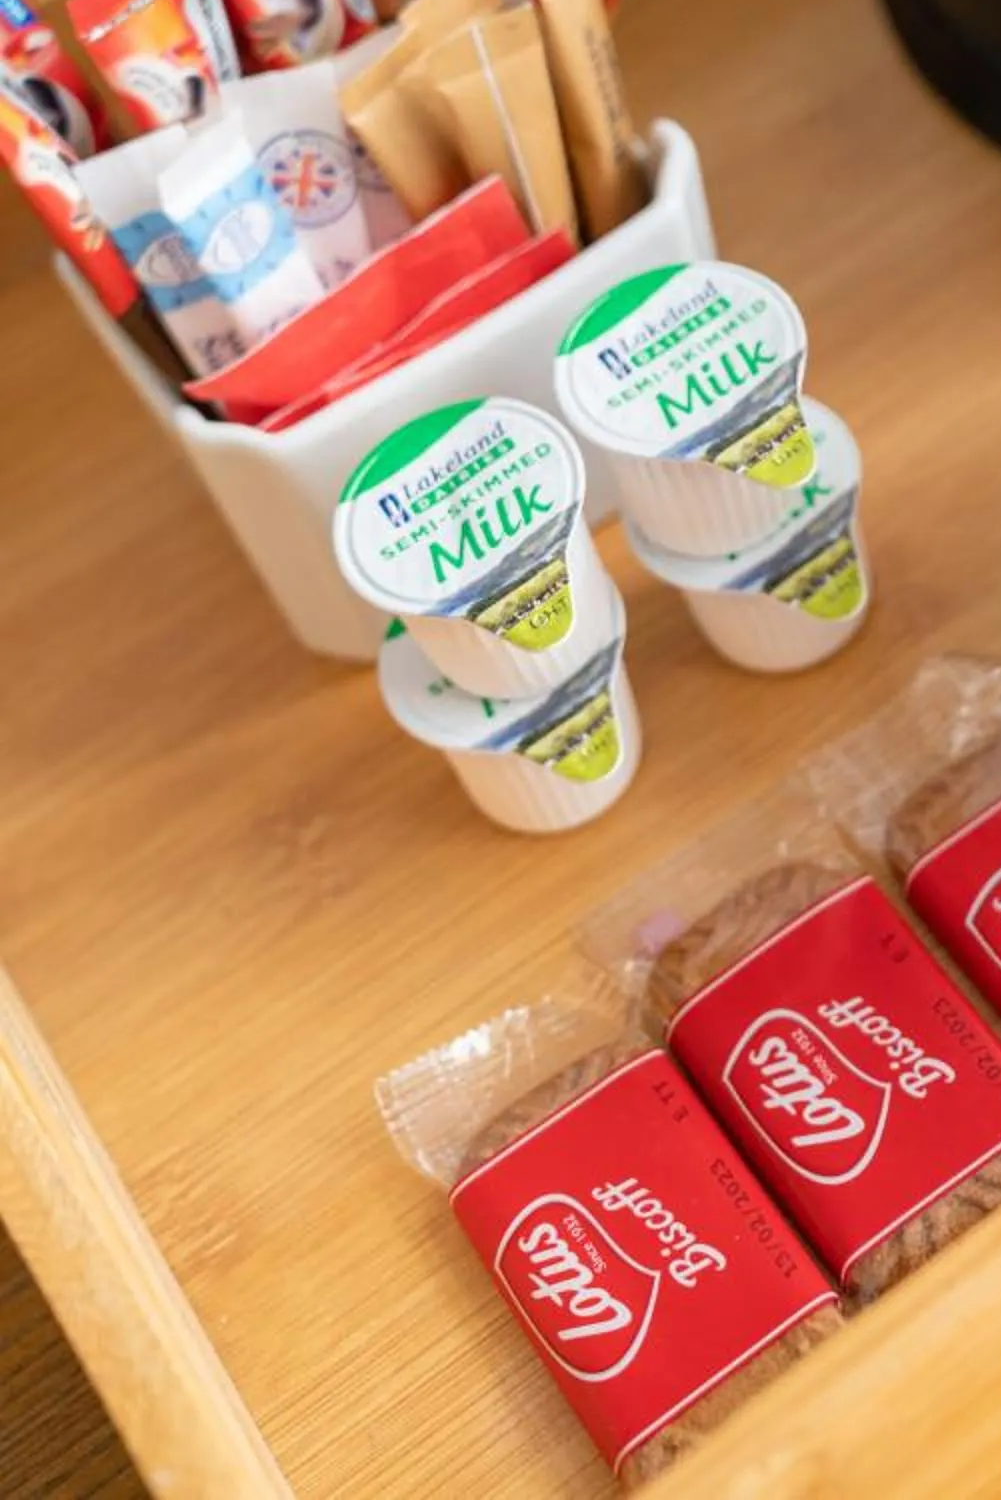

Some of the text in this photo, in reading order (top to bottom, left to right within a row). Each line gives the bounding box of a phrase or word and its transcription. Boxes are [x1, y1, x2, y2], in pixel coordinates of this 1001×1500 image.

[607, 299, 768, 408] SEMI-SKIMMED
[620, 280, 720, 351] Lakeland
[656, 340, 776, 429] Milk
[380, 442, 551, 560] SEMI-SKIMMED
[403, 421, 507, 500] Lakeland
[429, 483, 553, 583] Milk
[748, 1036, 865, 1147] Lotus
[818, 996, 956, 1098] Biscoff
[563, 1213, 607, 1273] Since 1932
[591, 1177, 727, 1288] Biscoff
[709, 1158, 798, 1280] 13/02/2023
[518, 1222, 633, 1342] Lotus
